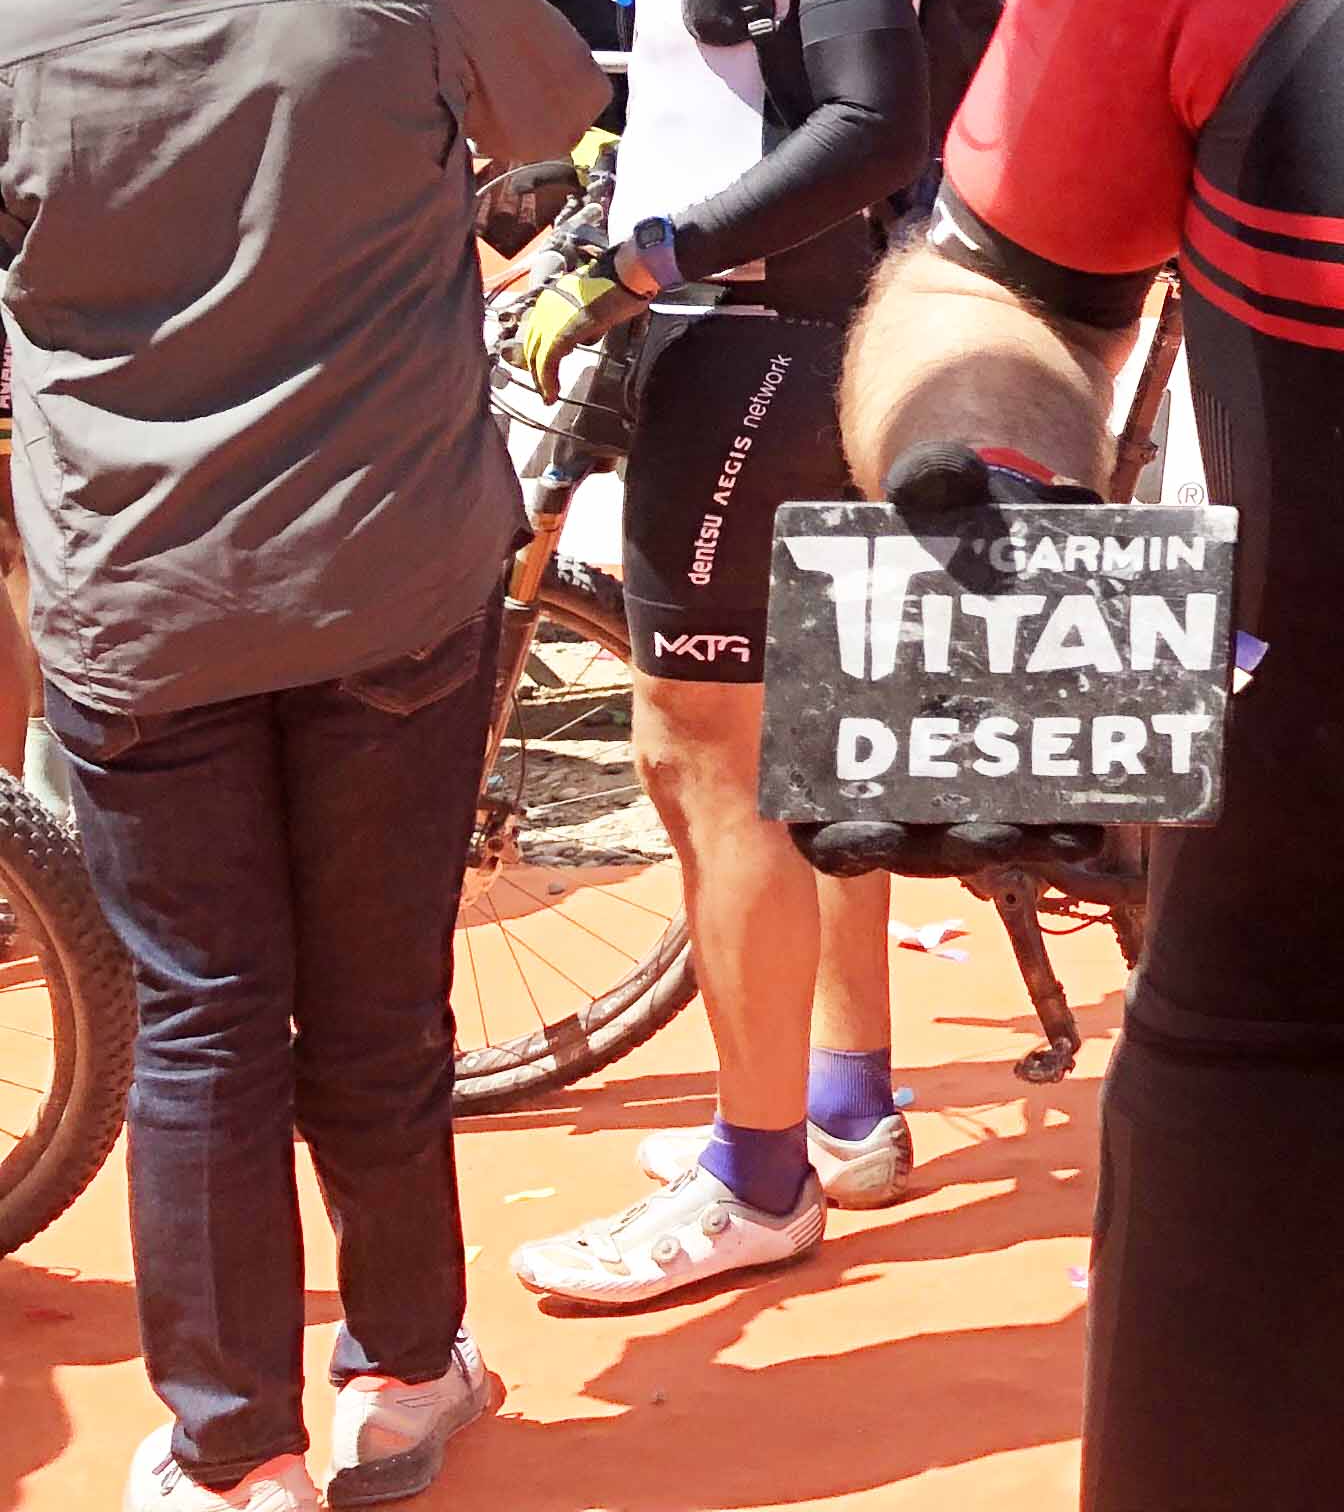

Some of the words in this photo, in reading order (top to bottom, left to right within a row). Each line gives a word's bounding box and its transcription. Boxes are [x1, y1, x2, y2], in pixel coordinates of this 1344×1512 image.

[688, 513, 724, 586] dentsu
[743, 353, 793, 429] network
[989, 535, 1205, 574] GARMIN
[783, 535, 1218, 682] TITAN
[836, 713, 1212, 781] DESERT
